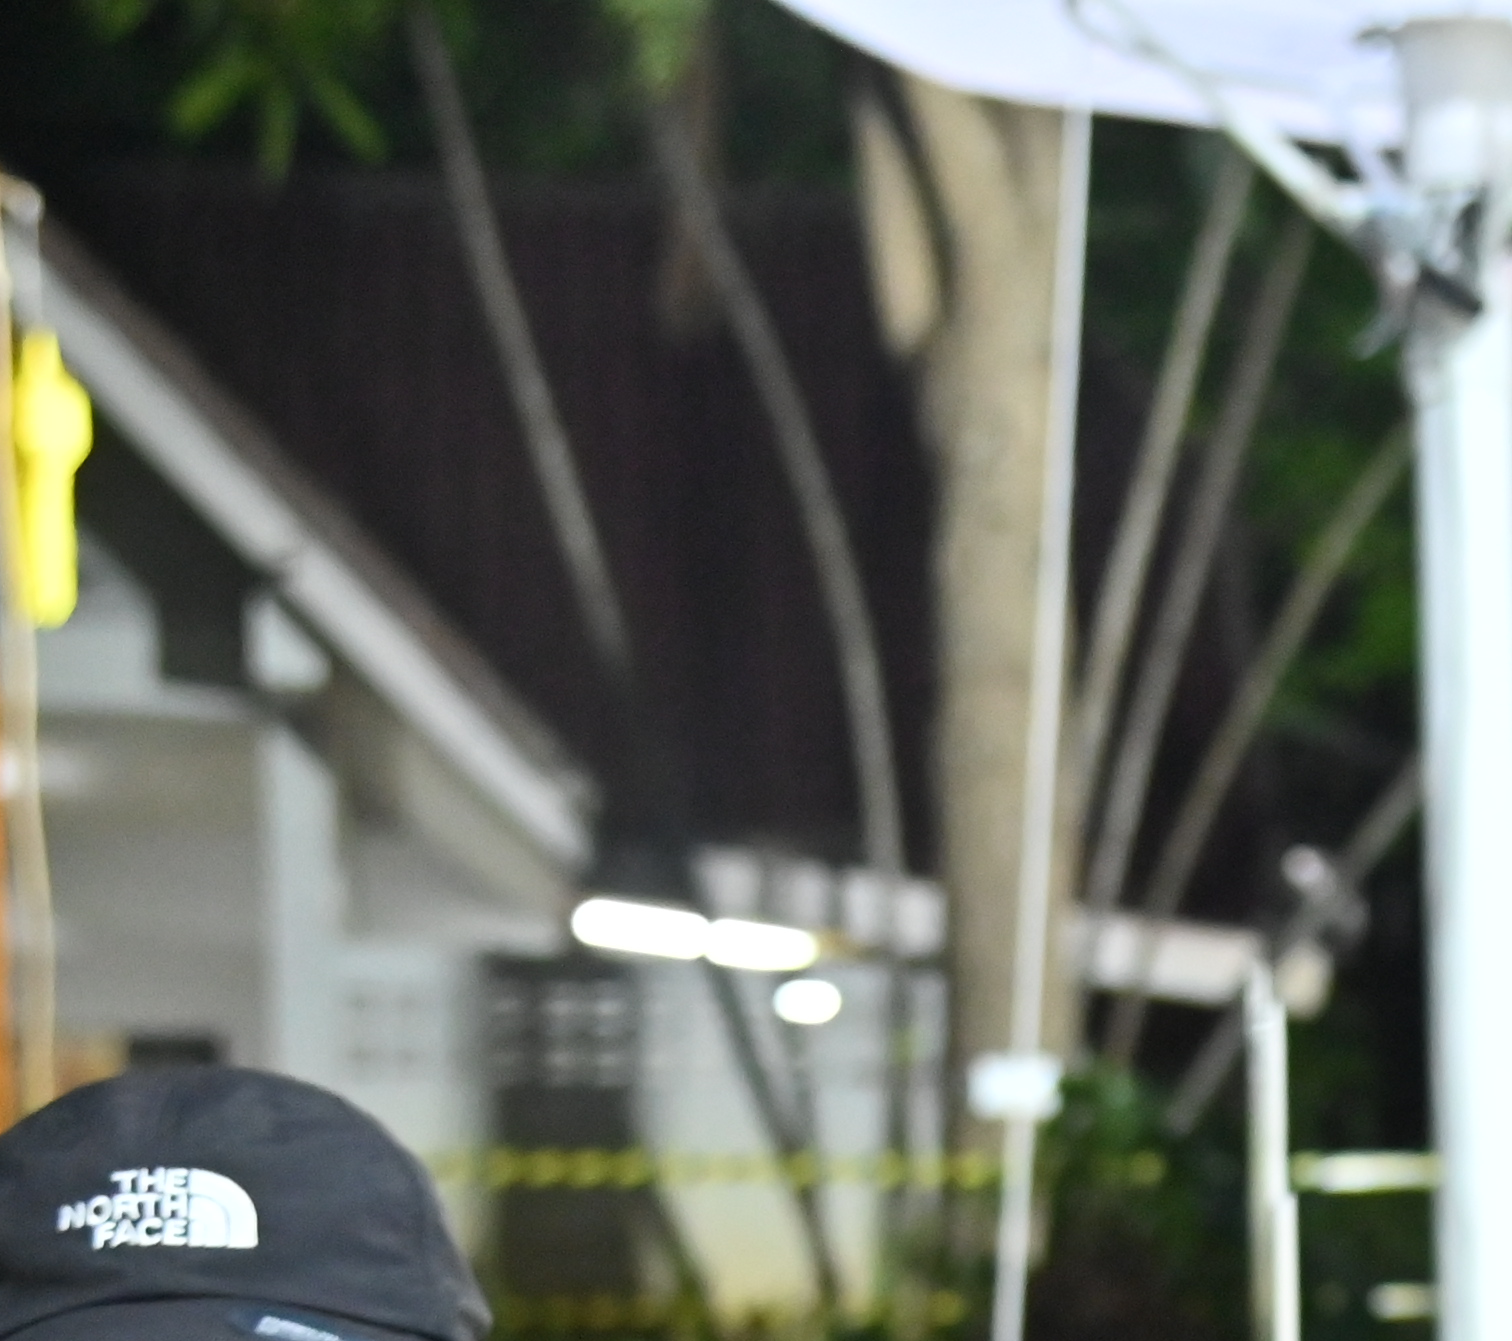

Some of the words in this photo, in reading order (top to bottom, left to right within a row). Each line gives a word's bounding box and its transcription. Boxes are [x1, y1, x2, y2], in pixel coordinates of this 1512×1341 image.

[110, 1166, 188, 1194] THE
[55, 1193, 188, 1234] NORTH
[92, 1217, 188, 1252] FACE
